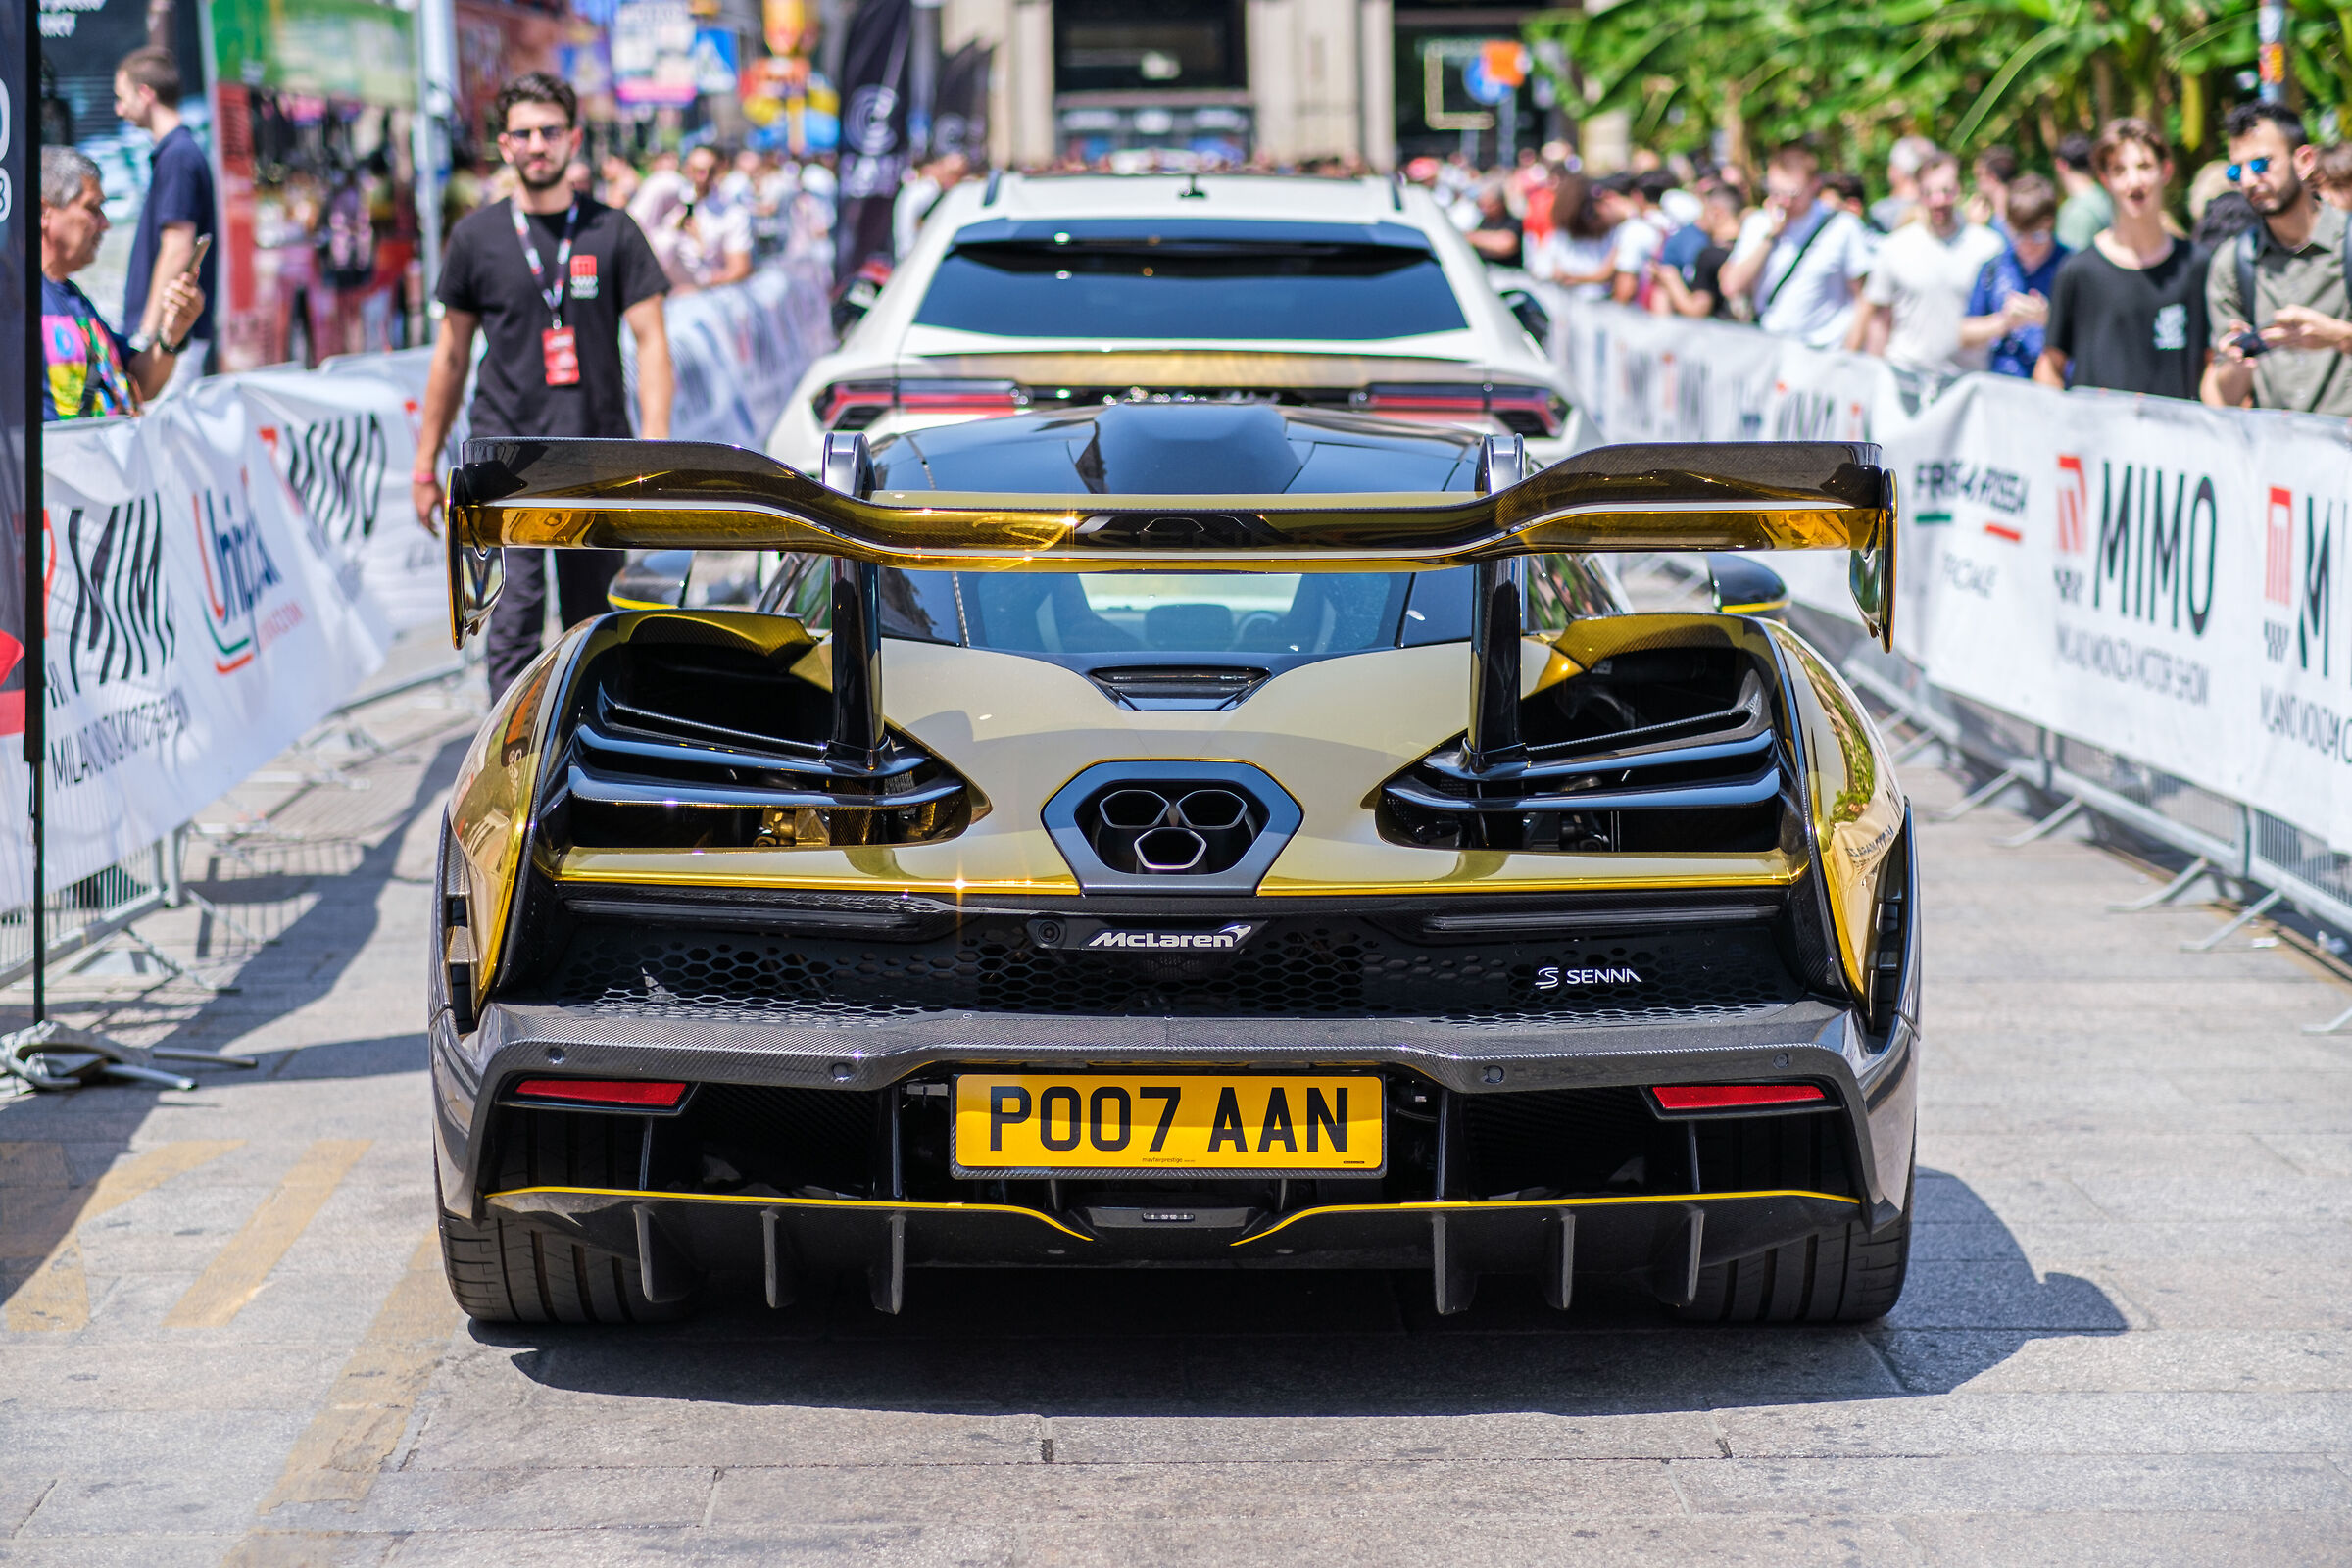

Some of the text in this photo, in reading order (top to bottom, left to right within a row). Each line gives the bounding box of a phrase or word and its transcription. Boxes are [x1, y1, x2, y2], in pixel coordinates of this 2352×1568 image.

[2093, 460, 2217, 637] MIMO
[1089, 929, 1237, 948] McLaren
[1566, 968, 1643, 985] SENNA
[1207, 1086, 1349, 1153] AAN
